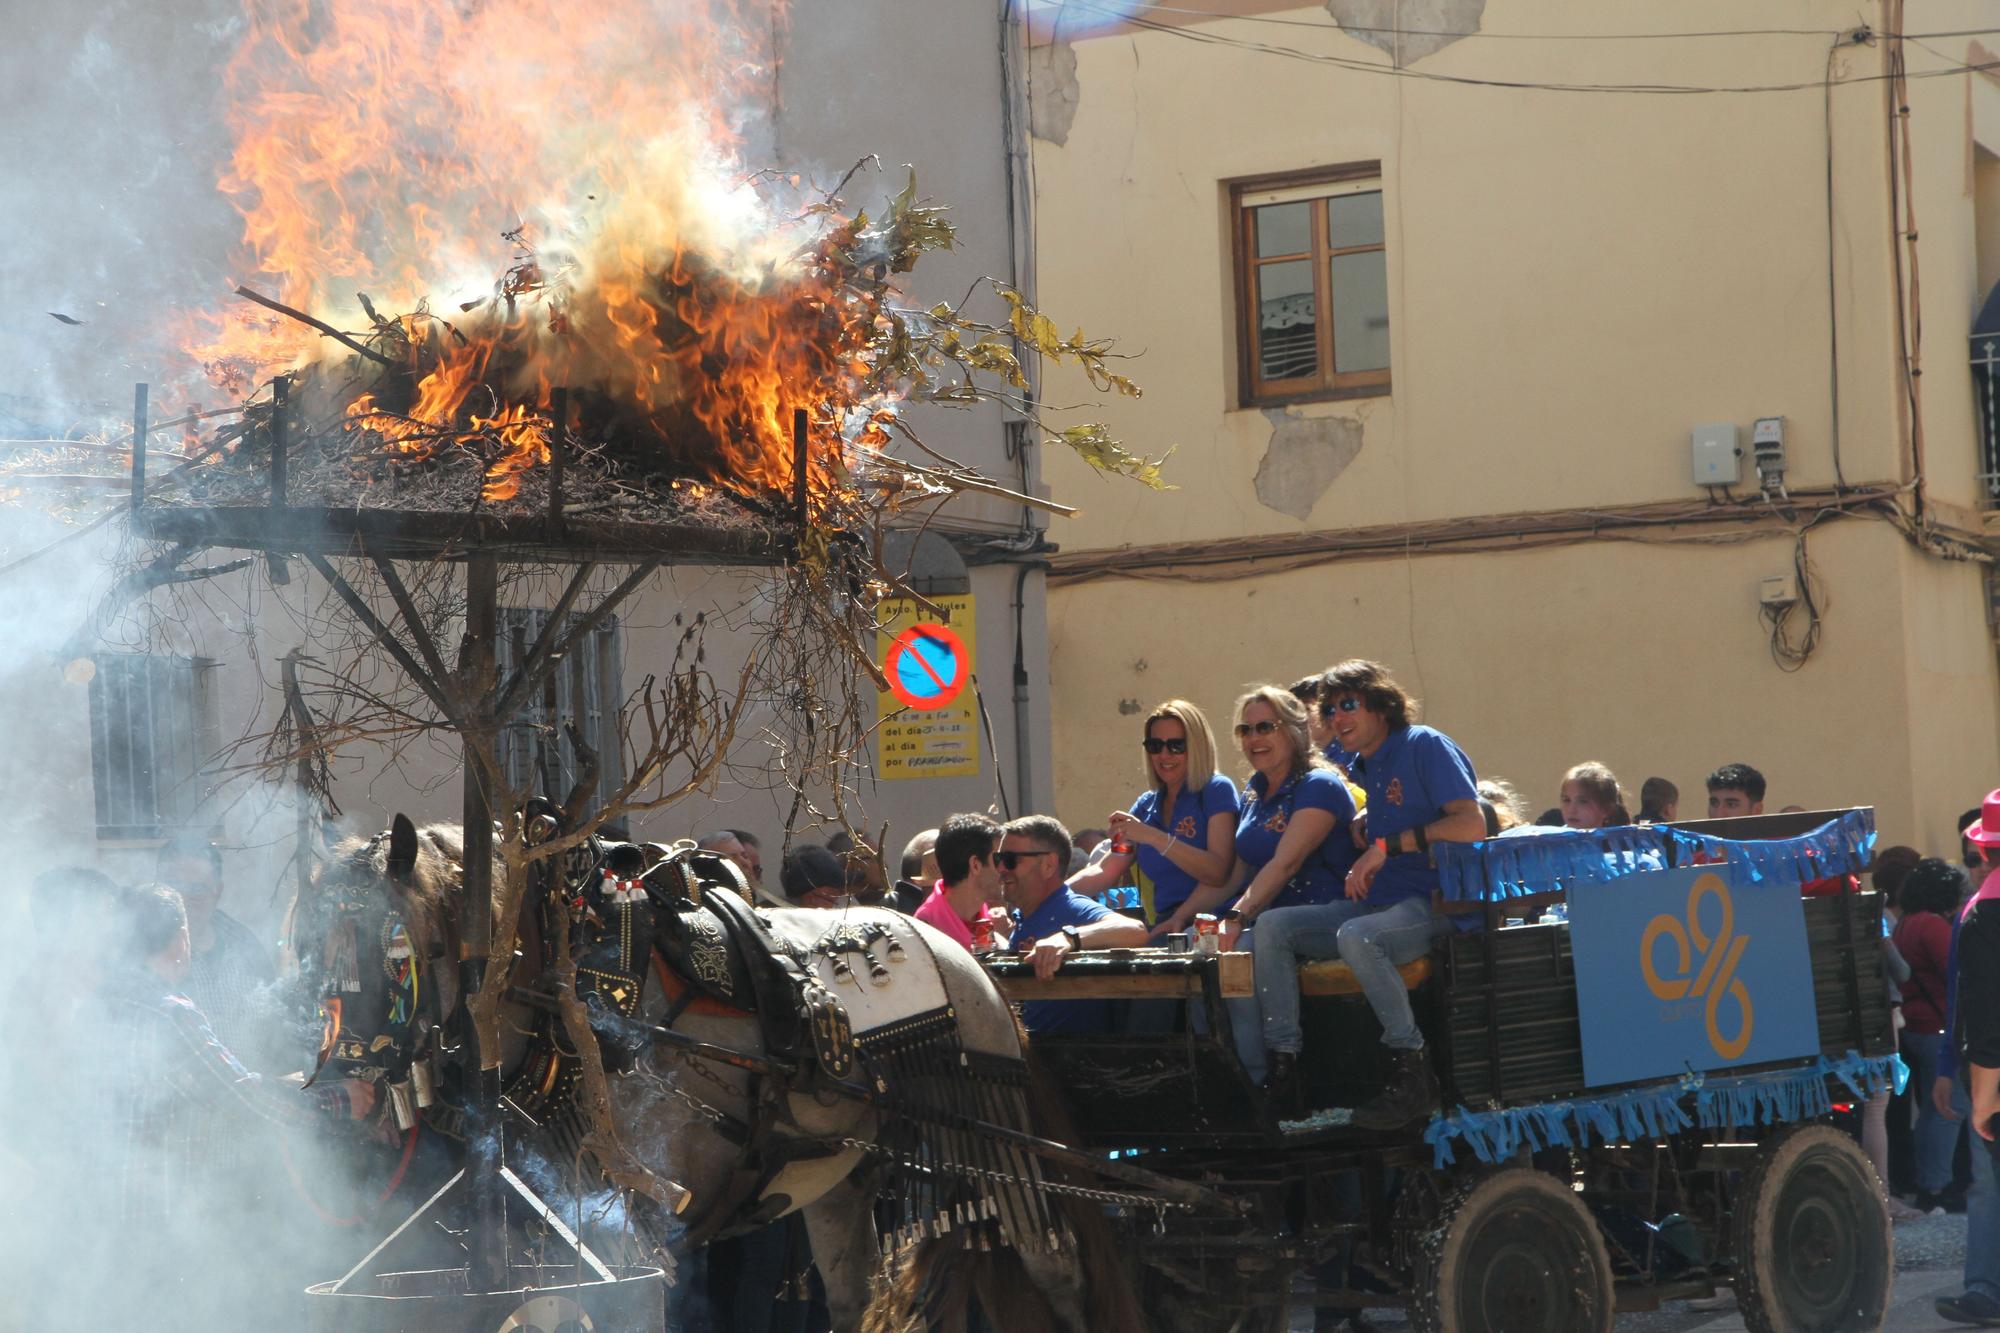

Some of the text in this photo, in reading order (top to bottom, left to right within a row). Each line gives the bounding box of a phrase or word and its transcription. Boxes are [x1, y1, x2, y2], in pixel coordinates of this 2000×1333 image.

[886, 728, 901, 736] del
[886, 742, 896, 751] al
[886, 758, 902, 768] por
